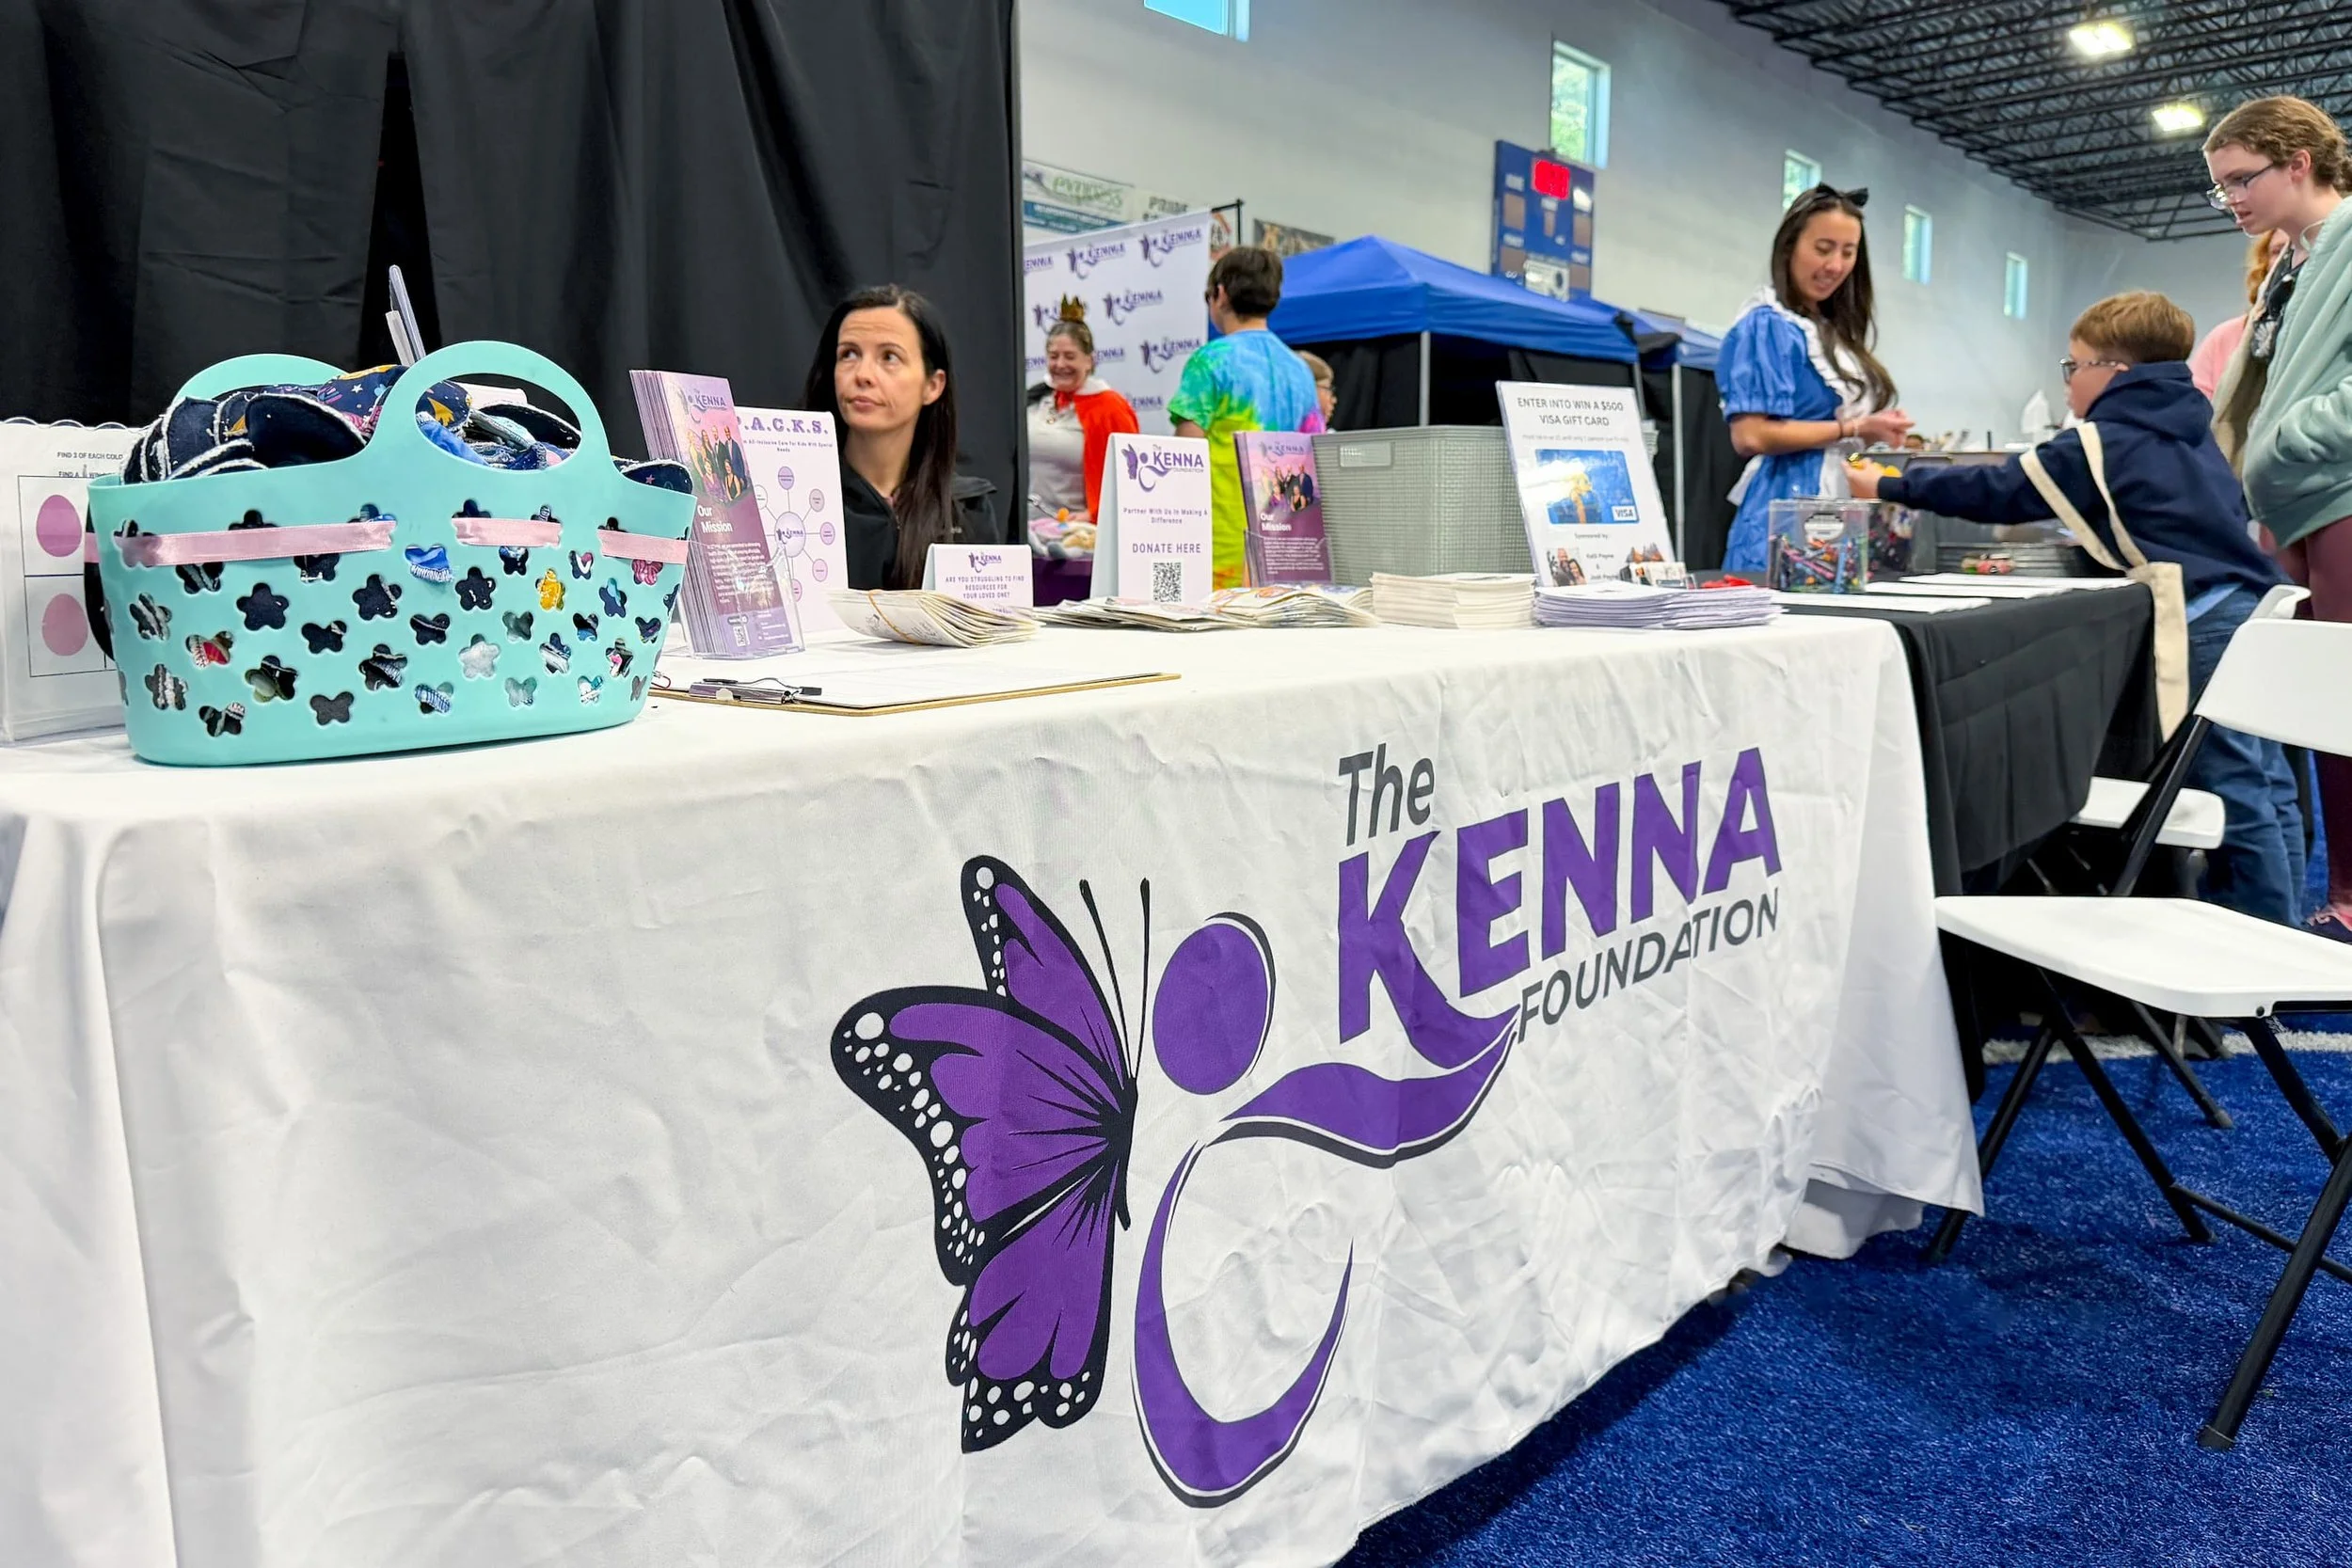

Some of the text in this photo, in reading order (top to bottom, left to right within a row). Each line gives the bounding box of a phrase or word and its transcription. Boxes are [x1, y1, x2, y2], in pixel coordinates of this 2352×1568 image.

[1025, 256, 1054, 270] ENNA
[1095, 348, 1124, 361] ENNA
[695, 395, 726, 407] KENNA
[1518, 397, 1548, 408] ENTER
[1572, 400, 1591, 410] WIN
[1594, 401, 1599, 409] A
[1601, 401, 1624, 412] $500
[1539, 415, 1610, 426] VISA GIFT CARD
[1152, 451, 1204, 468] KENNA
[697, 505, 713, 516] Our
[1260, 513, 1274, 521] Our
[1614, 508, 1633, 518] VISA
[701, 520, 733, 533] Mission
[1262, 522, 1292, 531] Mission
[1132, 543, 1201, 553] DONATE HERE
[1338, 742, 1435, 847] The
[1338, 747, 1782, 1055] KENNA
[1518, 888, 1780, 1044] FOUNDATION
